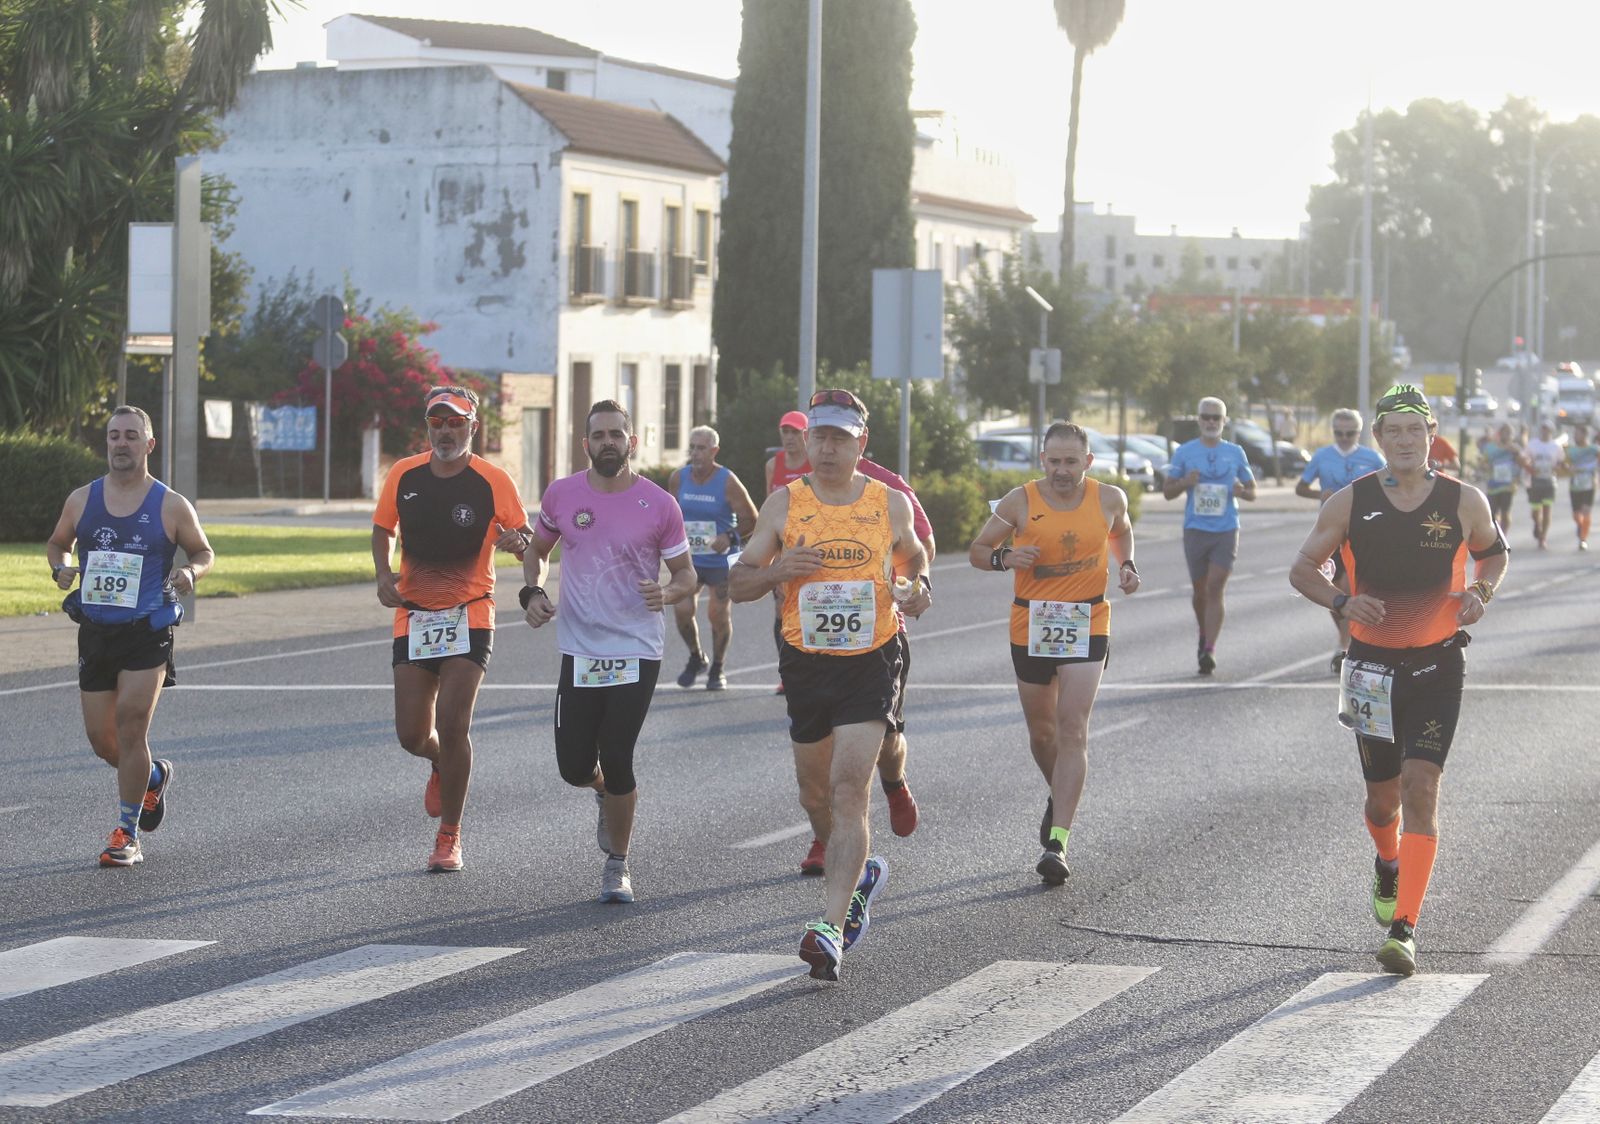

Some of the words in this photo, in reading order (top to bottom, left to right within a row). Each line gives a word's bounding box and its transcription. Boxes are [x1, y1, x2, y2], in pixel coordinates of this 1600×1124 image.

[1199, 497, 1220, 508] 308
[93, 575, 128, 593] 189
[815, 612, 862, 633] 296
[422, 626, 458, 646] 175
[1041, 626, 1078, 644] 225
[589, 658, 627, 673] 205
[1412, 664, 1437, 677] orca
[1350, 697, 1373, 720] 94
